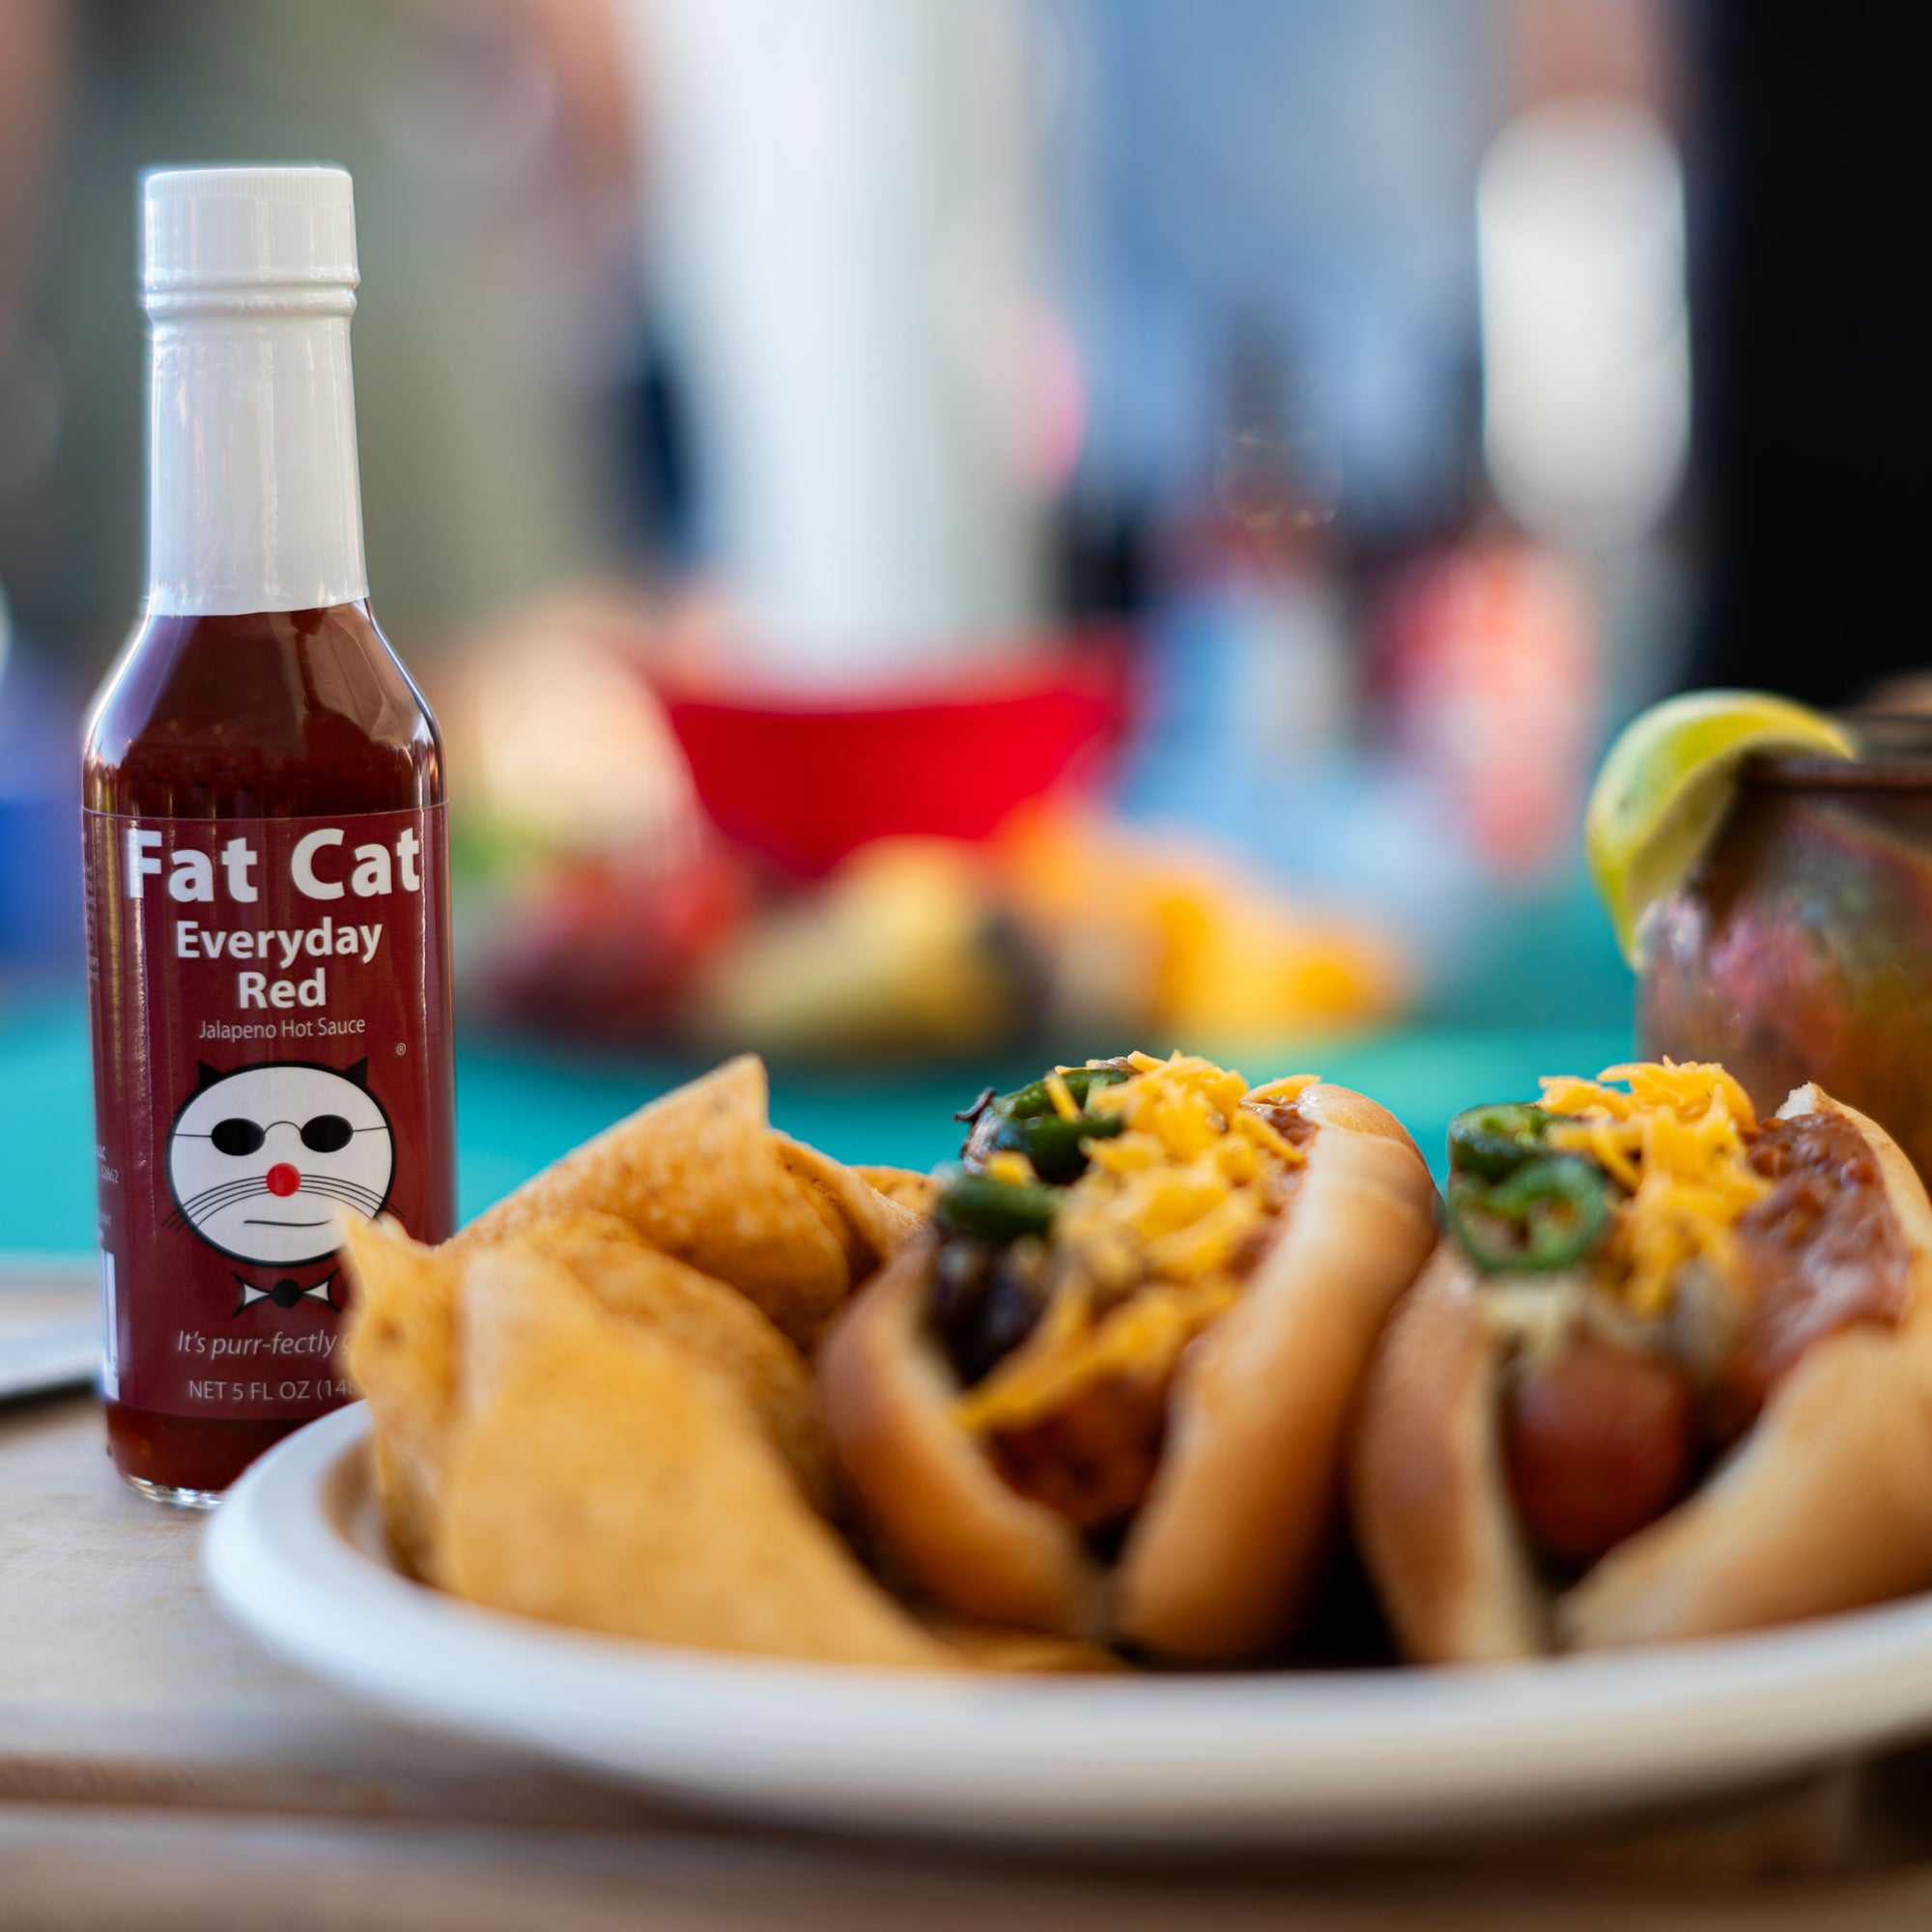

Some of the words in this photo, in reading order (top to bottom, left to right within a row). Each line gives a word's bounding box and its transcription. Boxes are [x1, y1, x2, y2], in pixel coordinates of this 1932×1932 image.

[128, 829, 259, 903] Fat
[291, 826, 420, 900] Cat
[177, 917, 383, 968] Everyday
[239, 967, 327, 1009] Red
[199, 1020, 277, 1042] Jalapeno
[281, 1020, 314, 1037] Hot
[318, 1017, 366, 1036] Sauce
[211, 1328, 338, 1360] purr-fectly
[188, 1380, 227, 1400] NET
[233, 1382, 243, 1400] 5
[251, 1381, 273, 1401] FL
[279, 1380, 311, 1400] OZ
